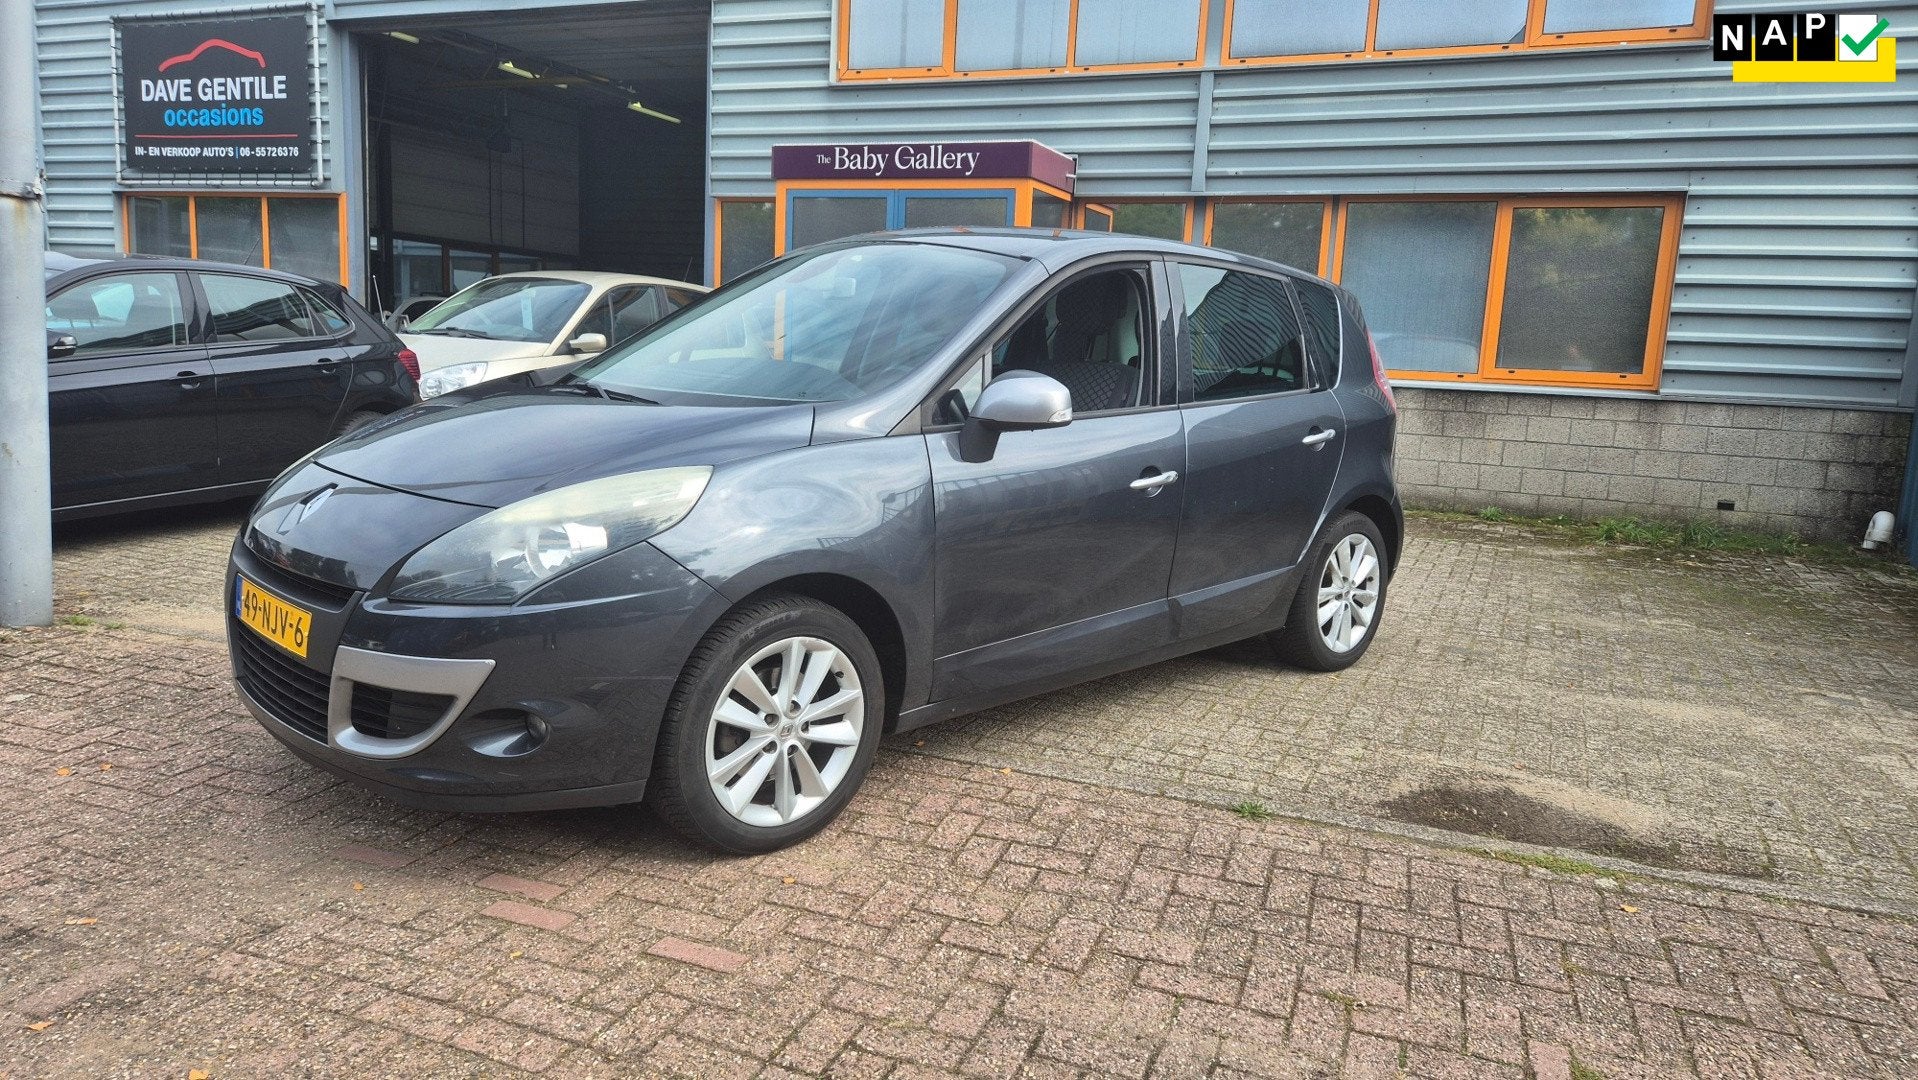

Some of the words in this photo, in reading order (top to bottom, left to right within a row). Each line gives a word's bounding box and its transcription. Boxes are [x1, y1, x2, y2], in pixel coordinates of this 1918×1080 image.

[141, 79, 192, 102] DAVE
[197, 75, 287, 101] GENTILE
[164, 103, 264, 127] occasions
[134, 146, 148, 156] IN-
[148, 146, 160, 156] EN
[161, 146, 201, 157] VERKOOP
[202, 146, 234, 157] AUTO'S
[816, 153, 831, 165] The
[833, 146, 888, 177] Baby
[894, 145, 980, 176] Gallery
[243, 589, 304, 648] 49-NJV-6
